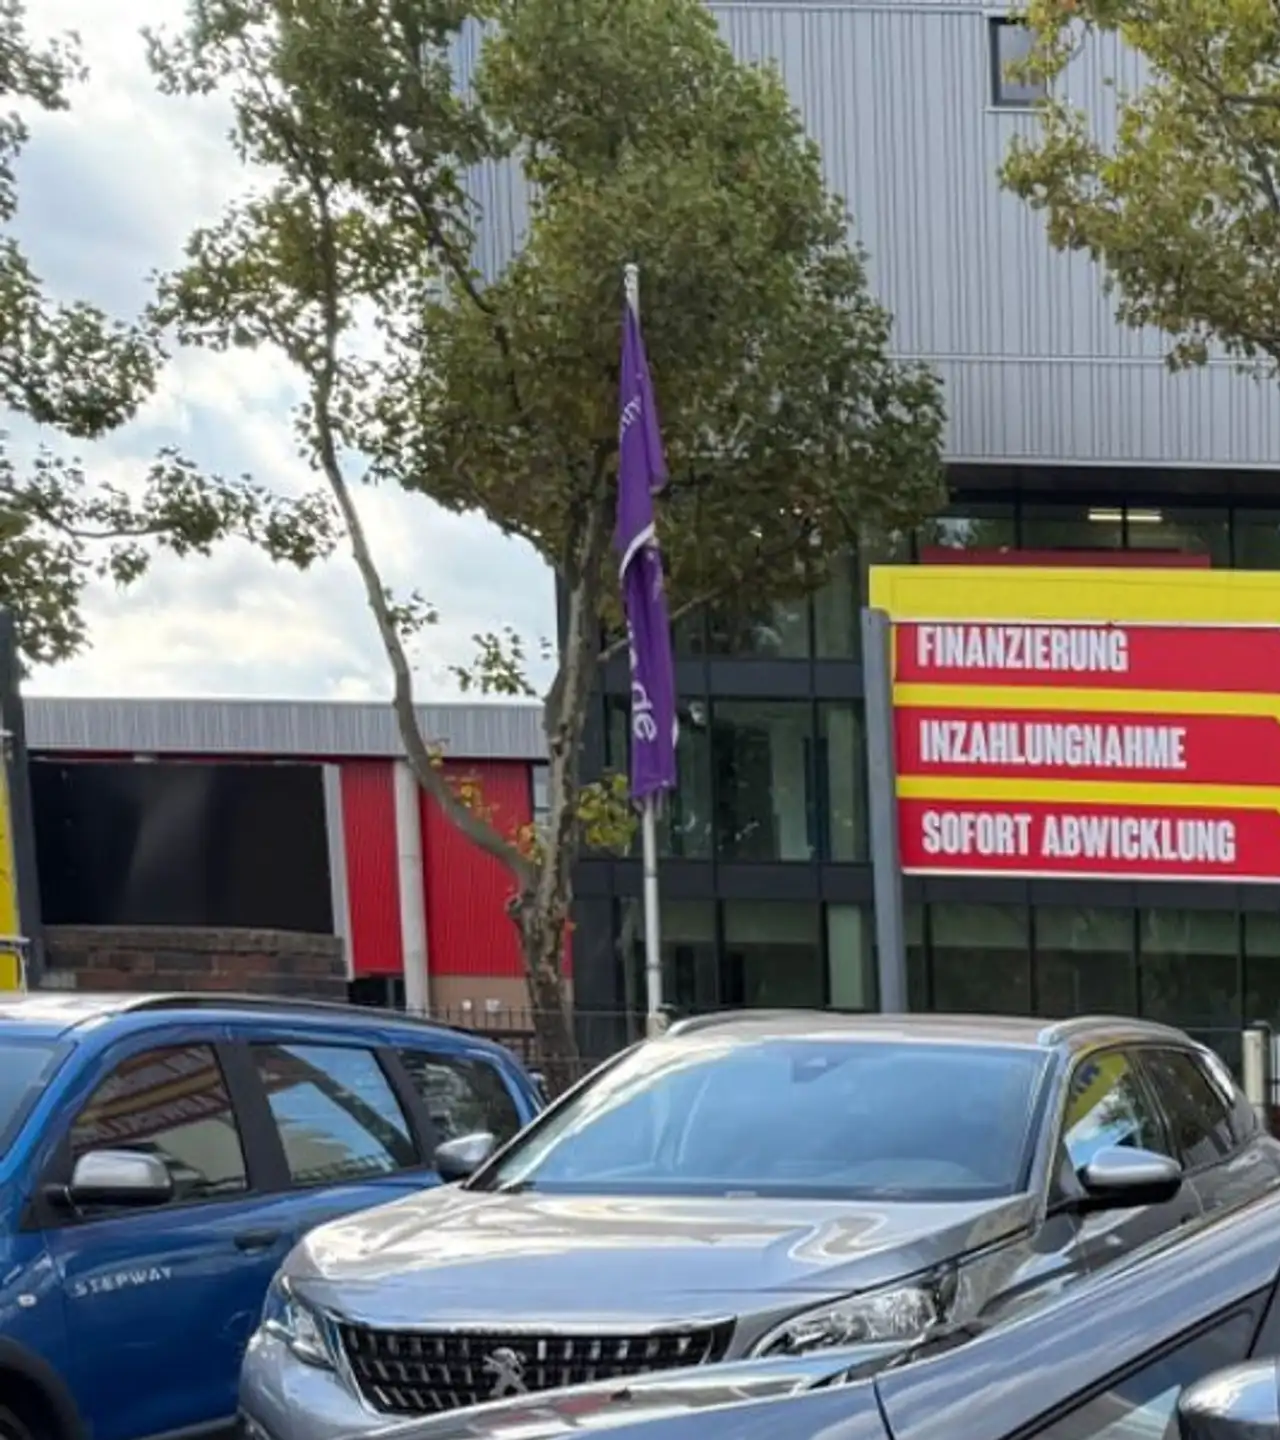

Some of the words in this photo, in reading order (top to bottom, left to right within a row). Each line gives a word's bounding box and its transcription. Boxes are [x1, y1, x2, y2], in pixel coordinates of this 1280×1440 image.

[916, 626, 1129, 673] FINANZIERUNG
[920, 720, 1188, 770] INZAHLUNGNAHME
[922, 811, 1032, 856] SOFORT
[1040, 816, 1236, 863] ABWICKLUNG
[74, 1266, 173, 1298] STEPWAY
